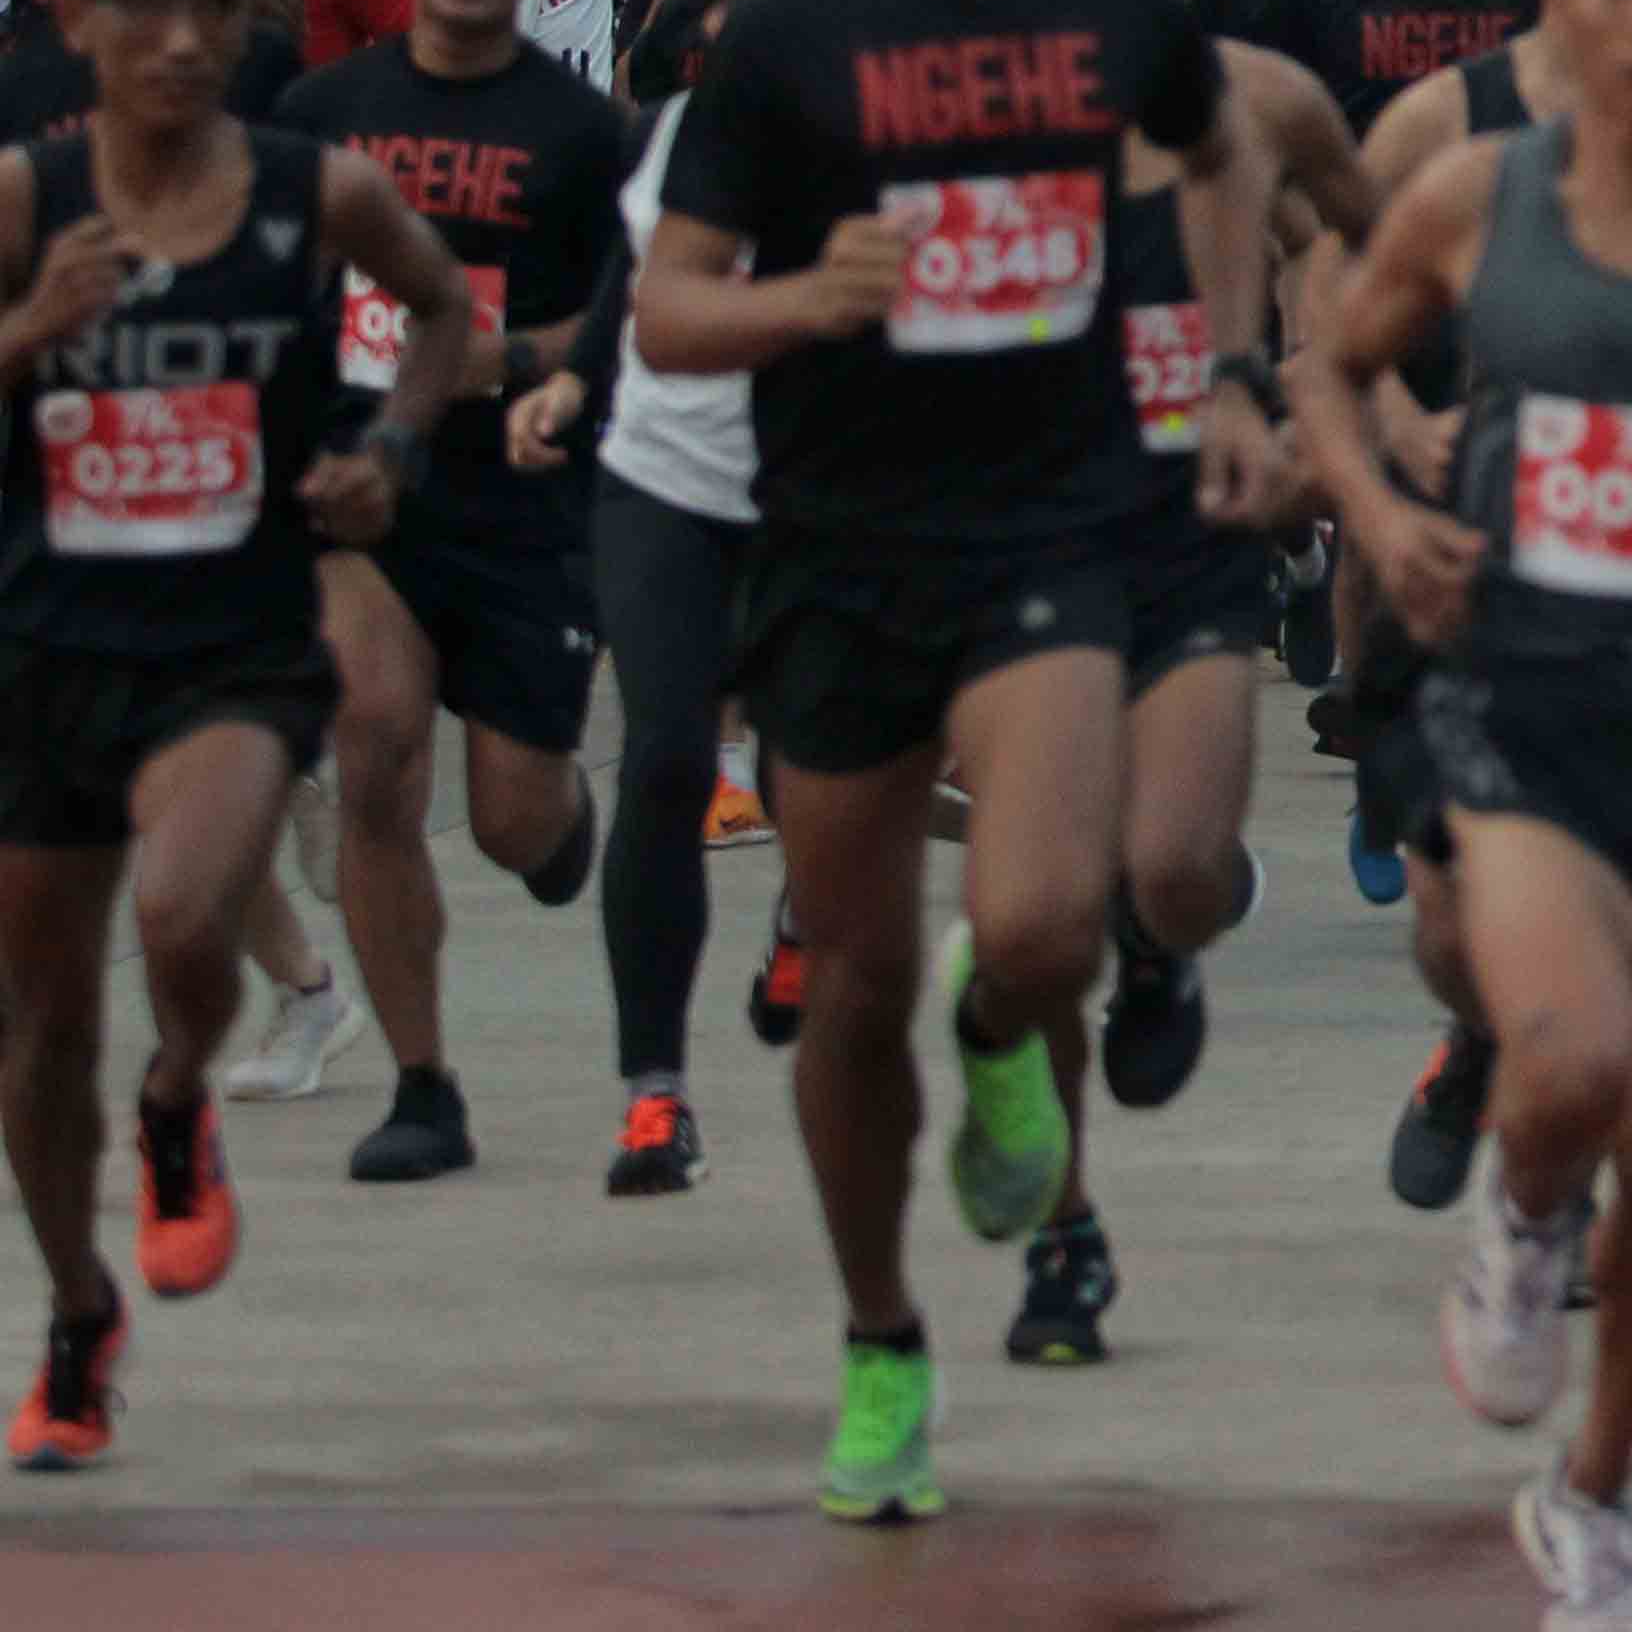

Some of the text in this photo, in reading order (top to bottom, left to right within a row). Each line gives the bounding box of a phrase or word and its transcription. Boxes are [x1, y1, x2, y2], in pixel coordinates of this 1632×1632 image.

[854, 32, 1118, 152] NGEHE
[348, 135, 531, 230] GEHE
[73, 436, 238, 499] 0225
